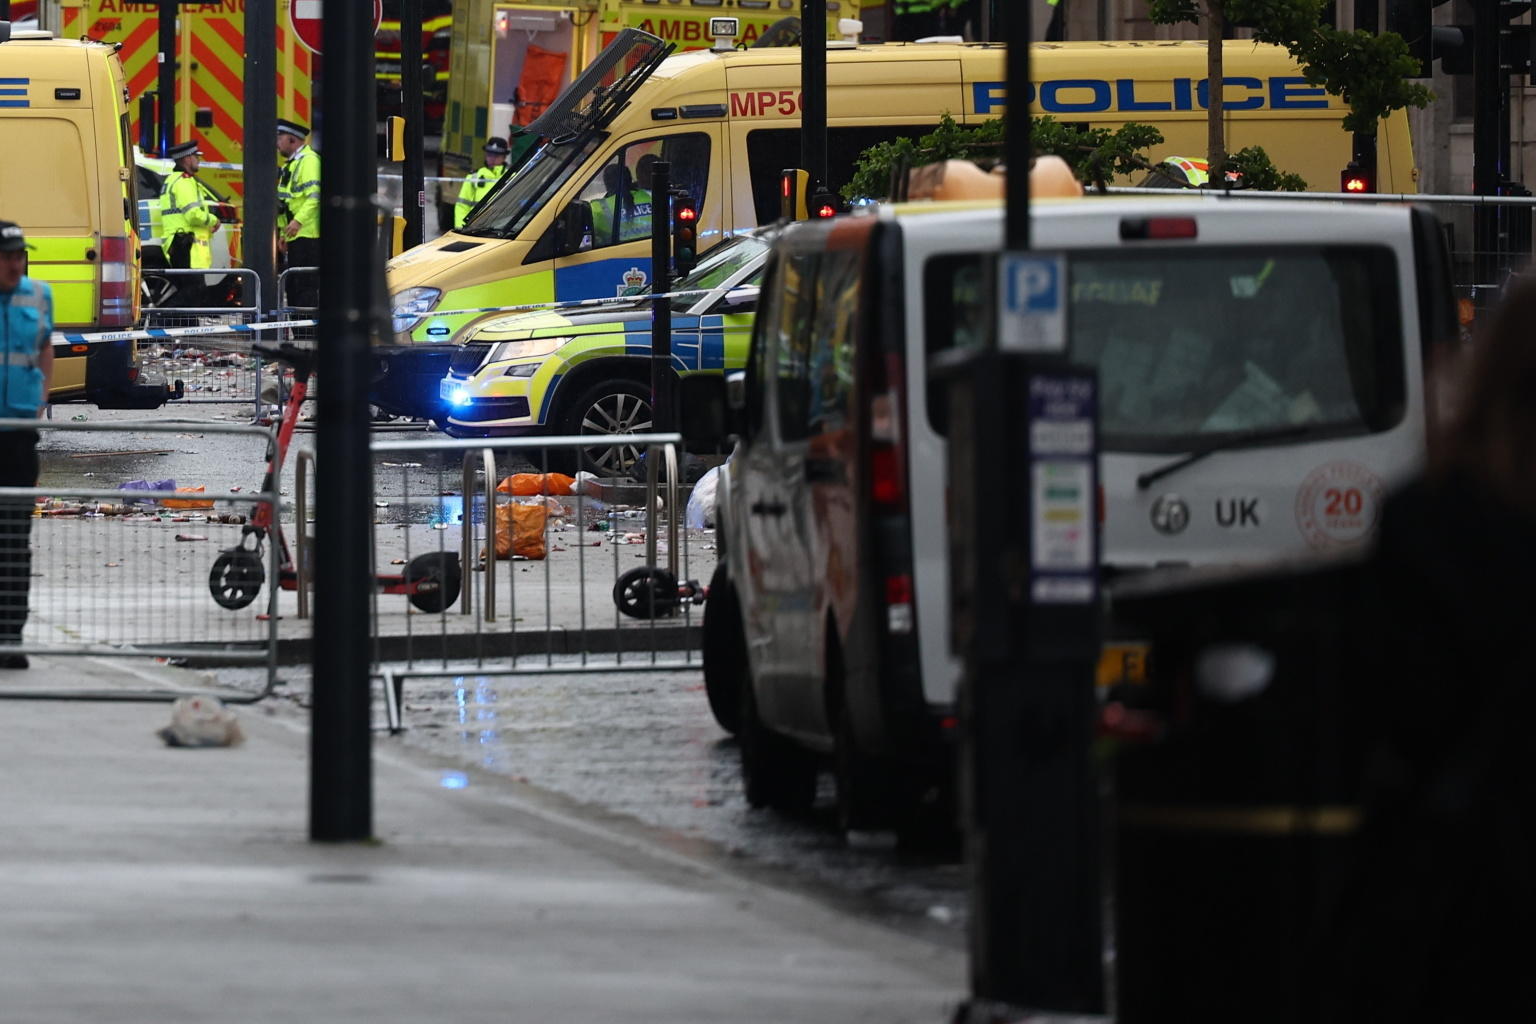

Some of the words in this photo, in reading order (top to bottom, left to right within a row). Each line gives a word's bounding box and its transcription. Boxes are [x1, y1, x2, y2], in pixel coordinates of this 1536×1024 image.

[730, 90, 802, 117] MP5
[973, 77, 1329, 114] POLICE
[621, 203, 652, 217] PLICE
[1018, 264, 1051, 311] P
[1215, 497, 1260, 528] UK
[1324, 487, 1363, 515] 20
